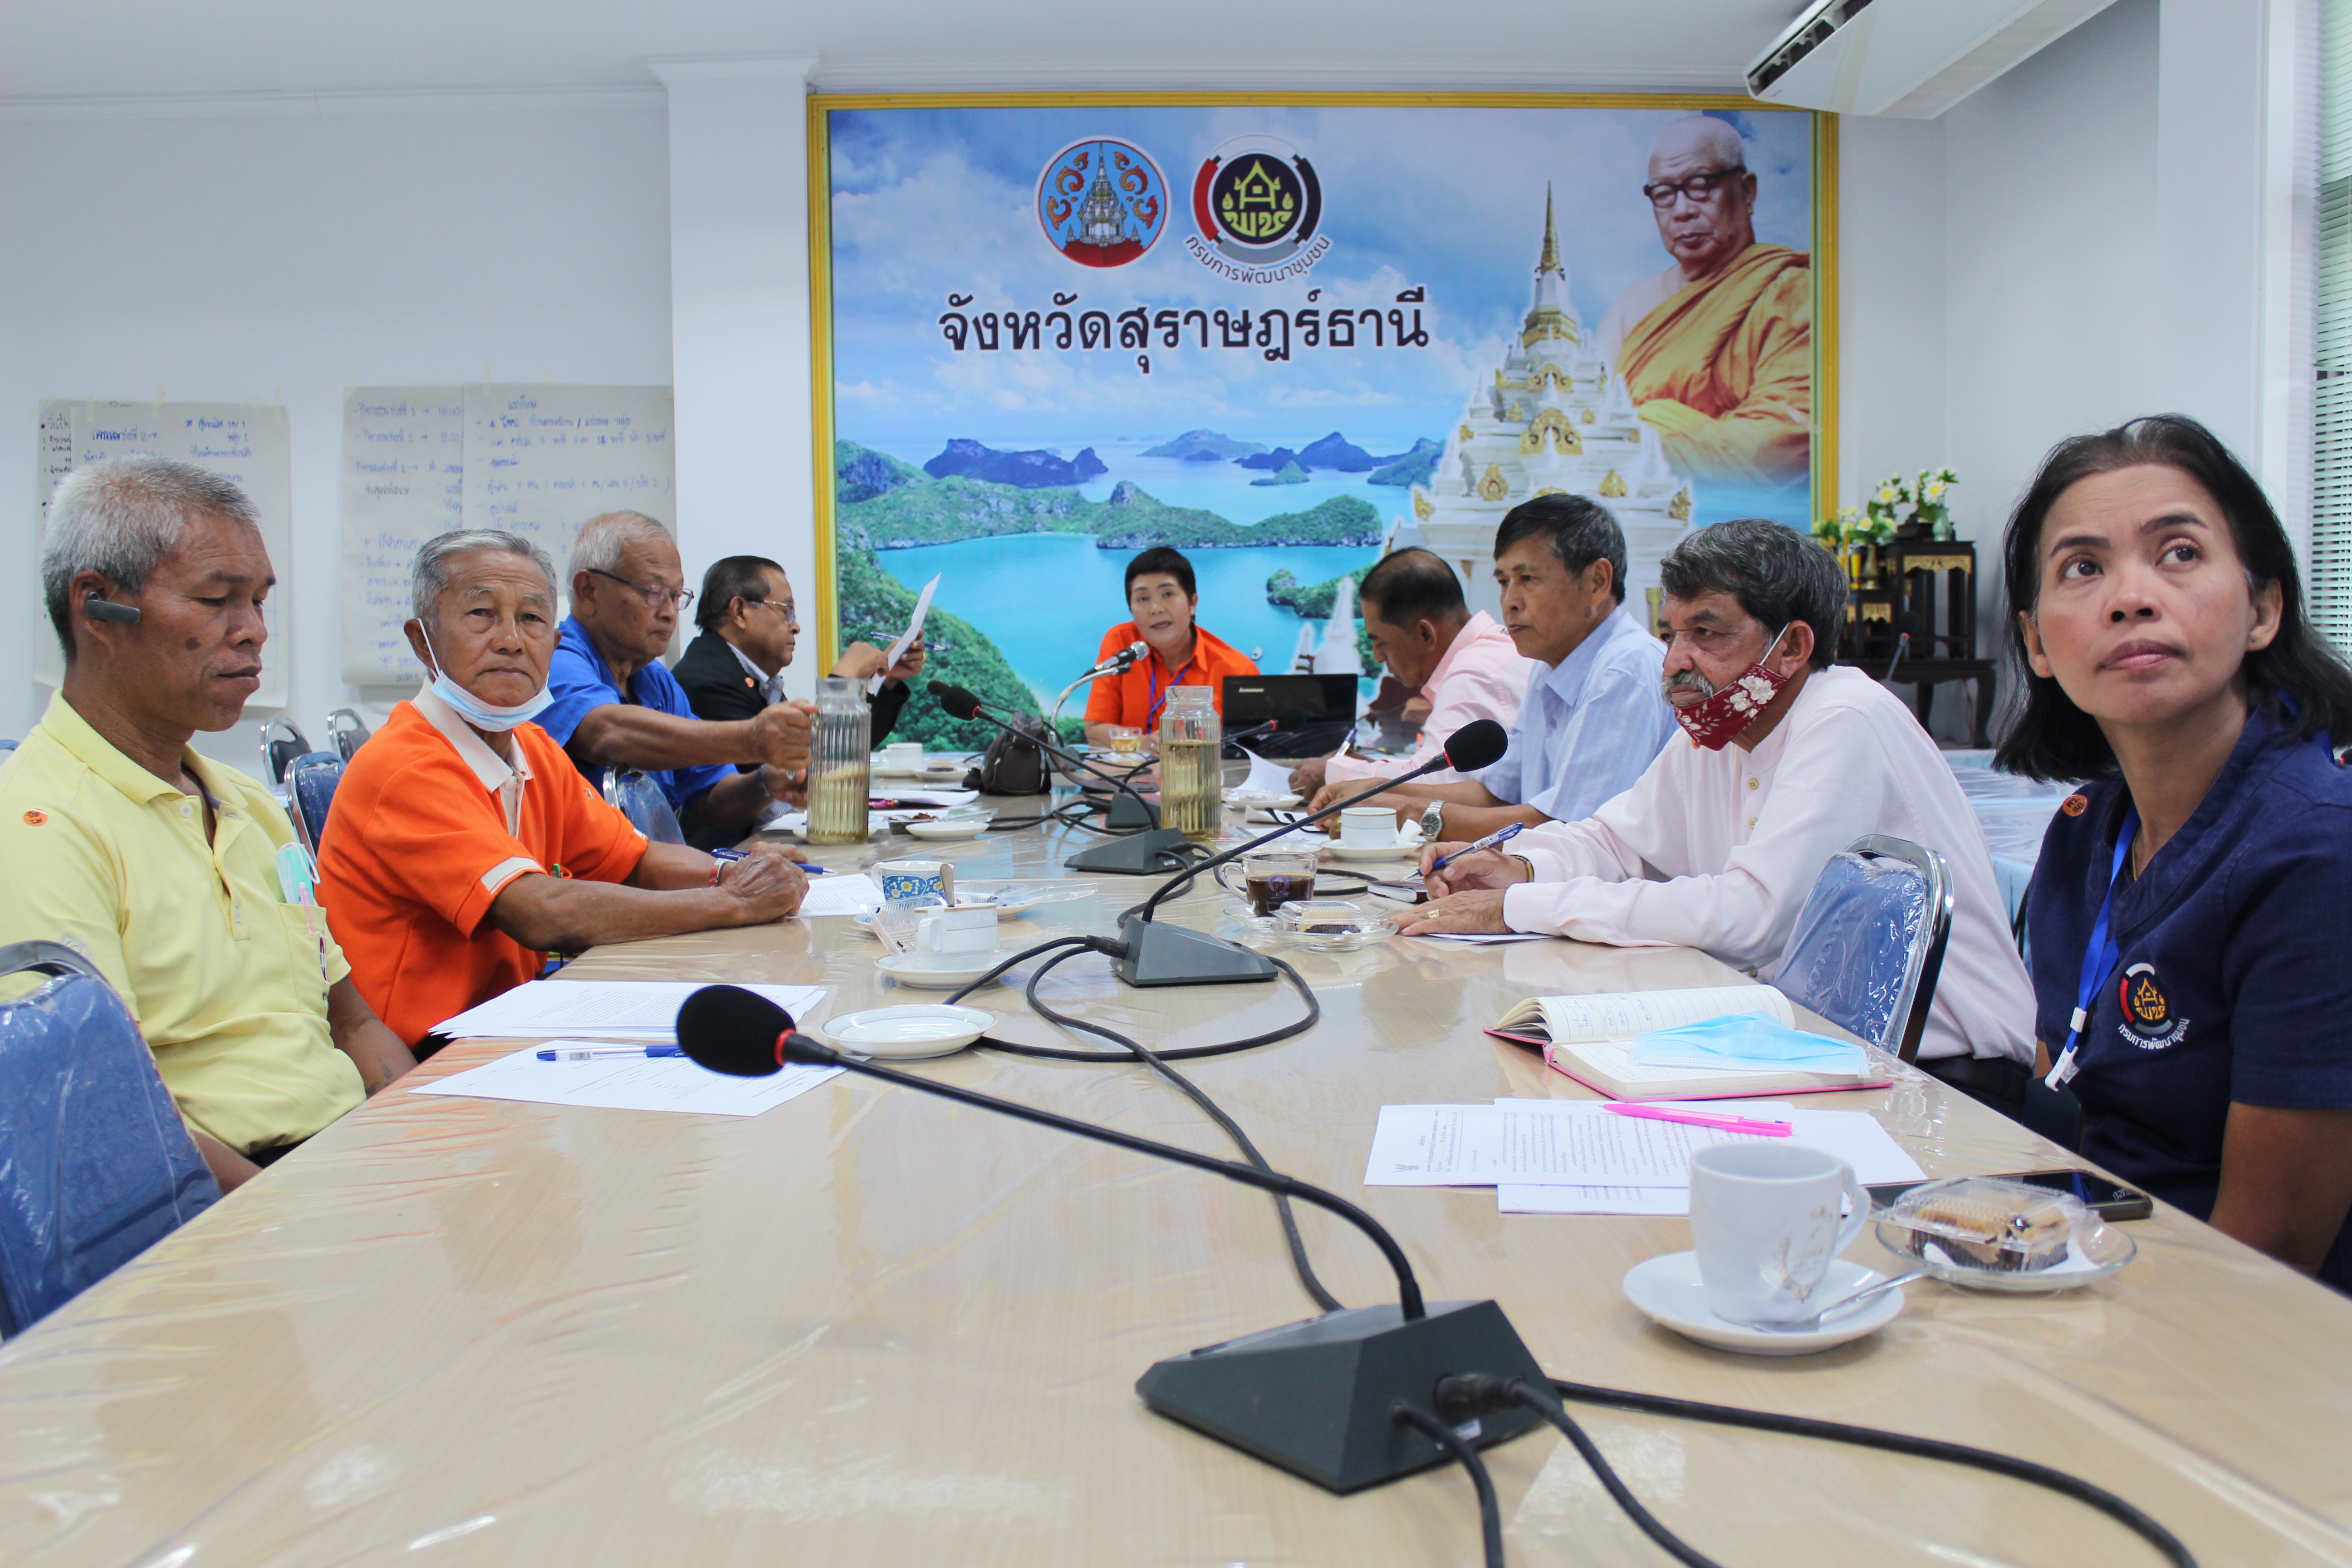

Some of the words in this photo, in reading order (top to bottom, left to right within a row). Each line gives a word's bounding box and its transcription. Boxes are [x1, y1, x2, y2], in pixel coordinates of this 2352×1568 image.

[1185, 236, 1330, 284] กรมการพัฒนาชุมชน
[941, 287, 1428, 373] จังหวัดสุราษฎร์ธานี
[2118, 1018, 2190, 1050] กรมการพัฒนาชุมชน
